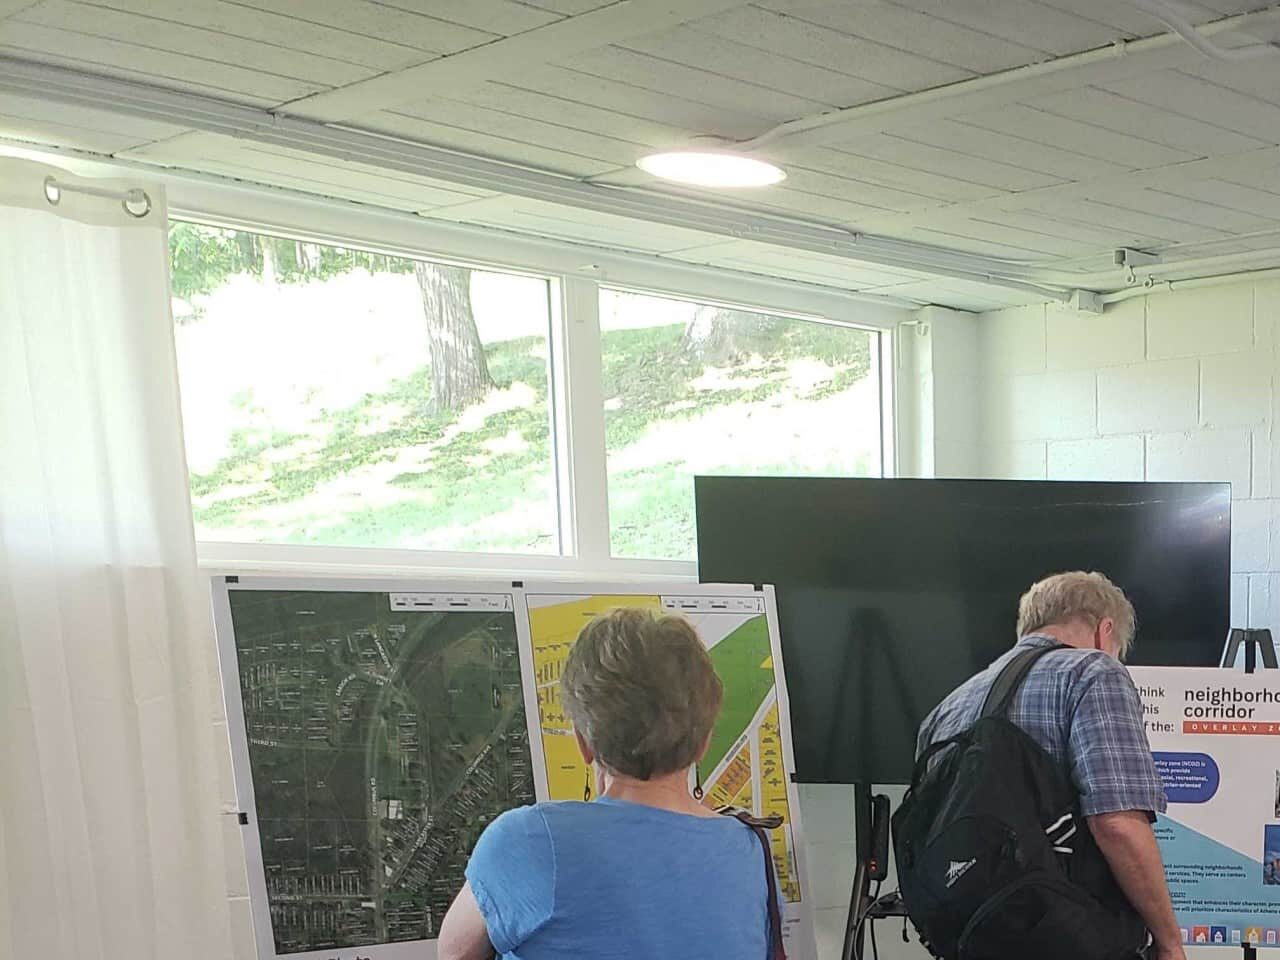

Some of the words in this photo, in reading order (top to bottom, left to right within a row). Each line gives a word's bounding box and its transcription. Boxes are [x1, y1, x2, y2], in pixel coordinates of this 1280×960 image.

[1136, 686, 1165, 698] hink
[1142, 703, 1160, 715] his
[1183, 703, 1255, 719] corridor
[1151, 721, 1175, 732] the:
[1191, 724, 1258, 732] OVERLAY
